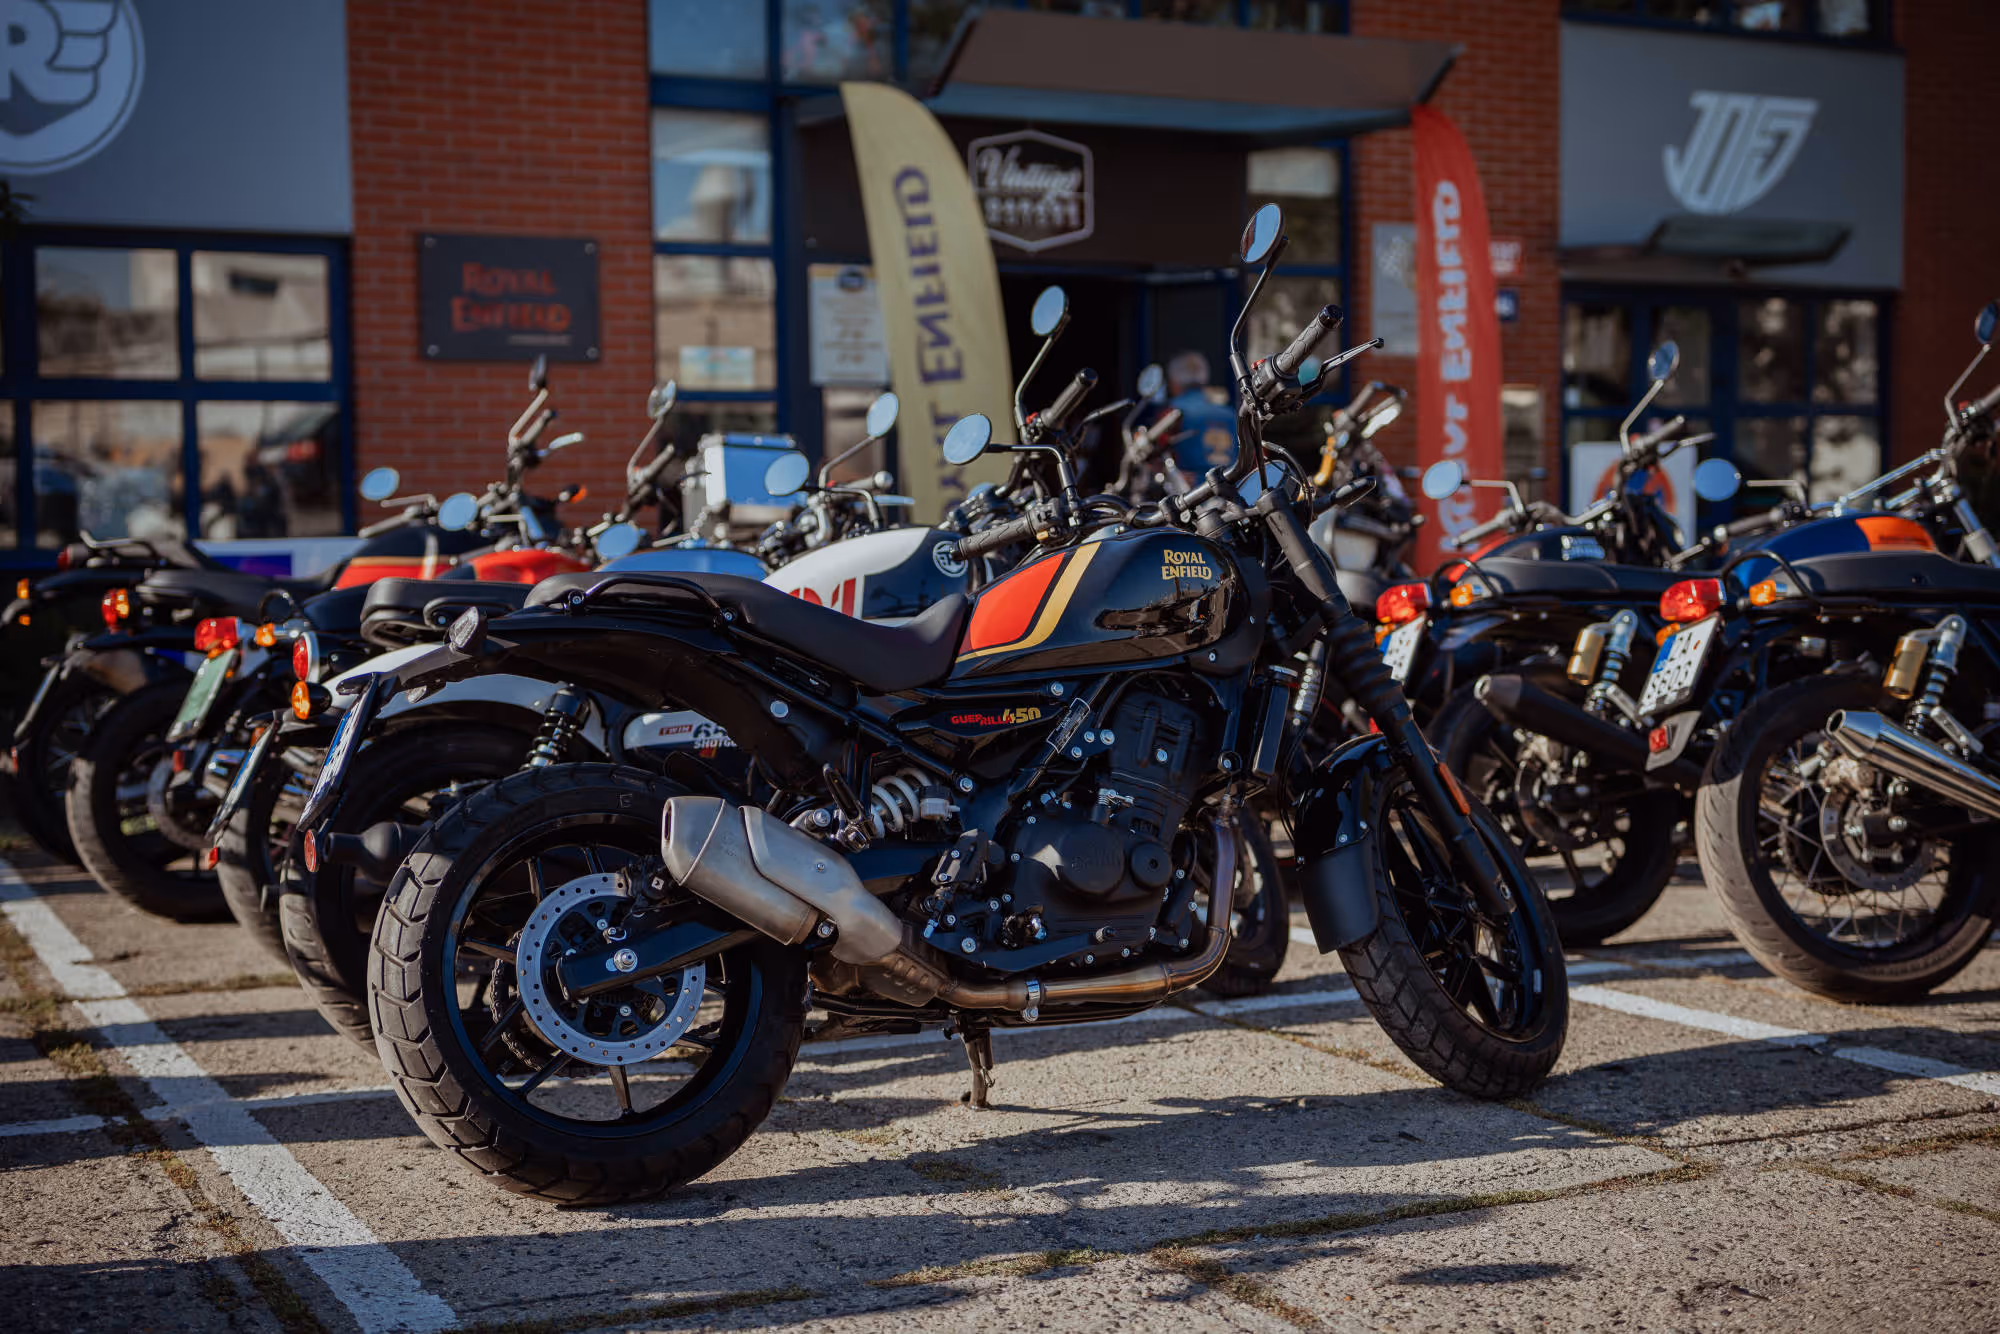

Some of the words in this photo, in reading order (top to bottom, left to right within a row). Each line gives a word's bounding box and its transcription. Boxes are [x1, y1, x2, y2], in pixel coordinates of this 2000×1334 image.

[1163, 549, 1206, 565] ROYAL
[1161, 565, 1213, 580] ENFIELD
[951, 713, 1013, 726] GUERRILLA
[1003, 707, 1041, 724] 450
[693, 739, 738, 750] SHOTG
